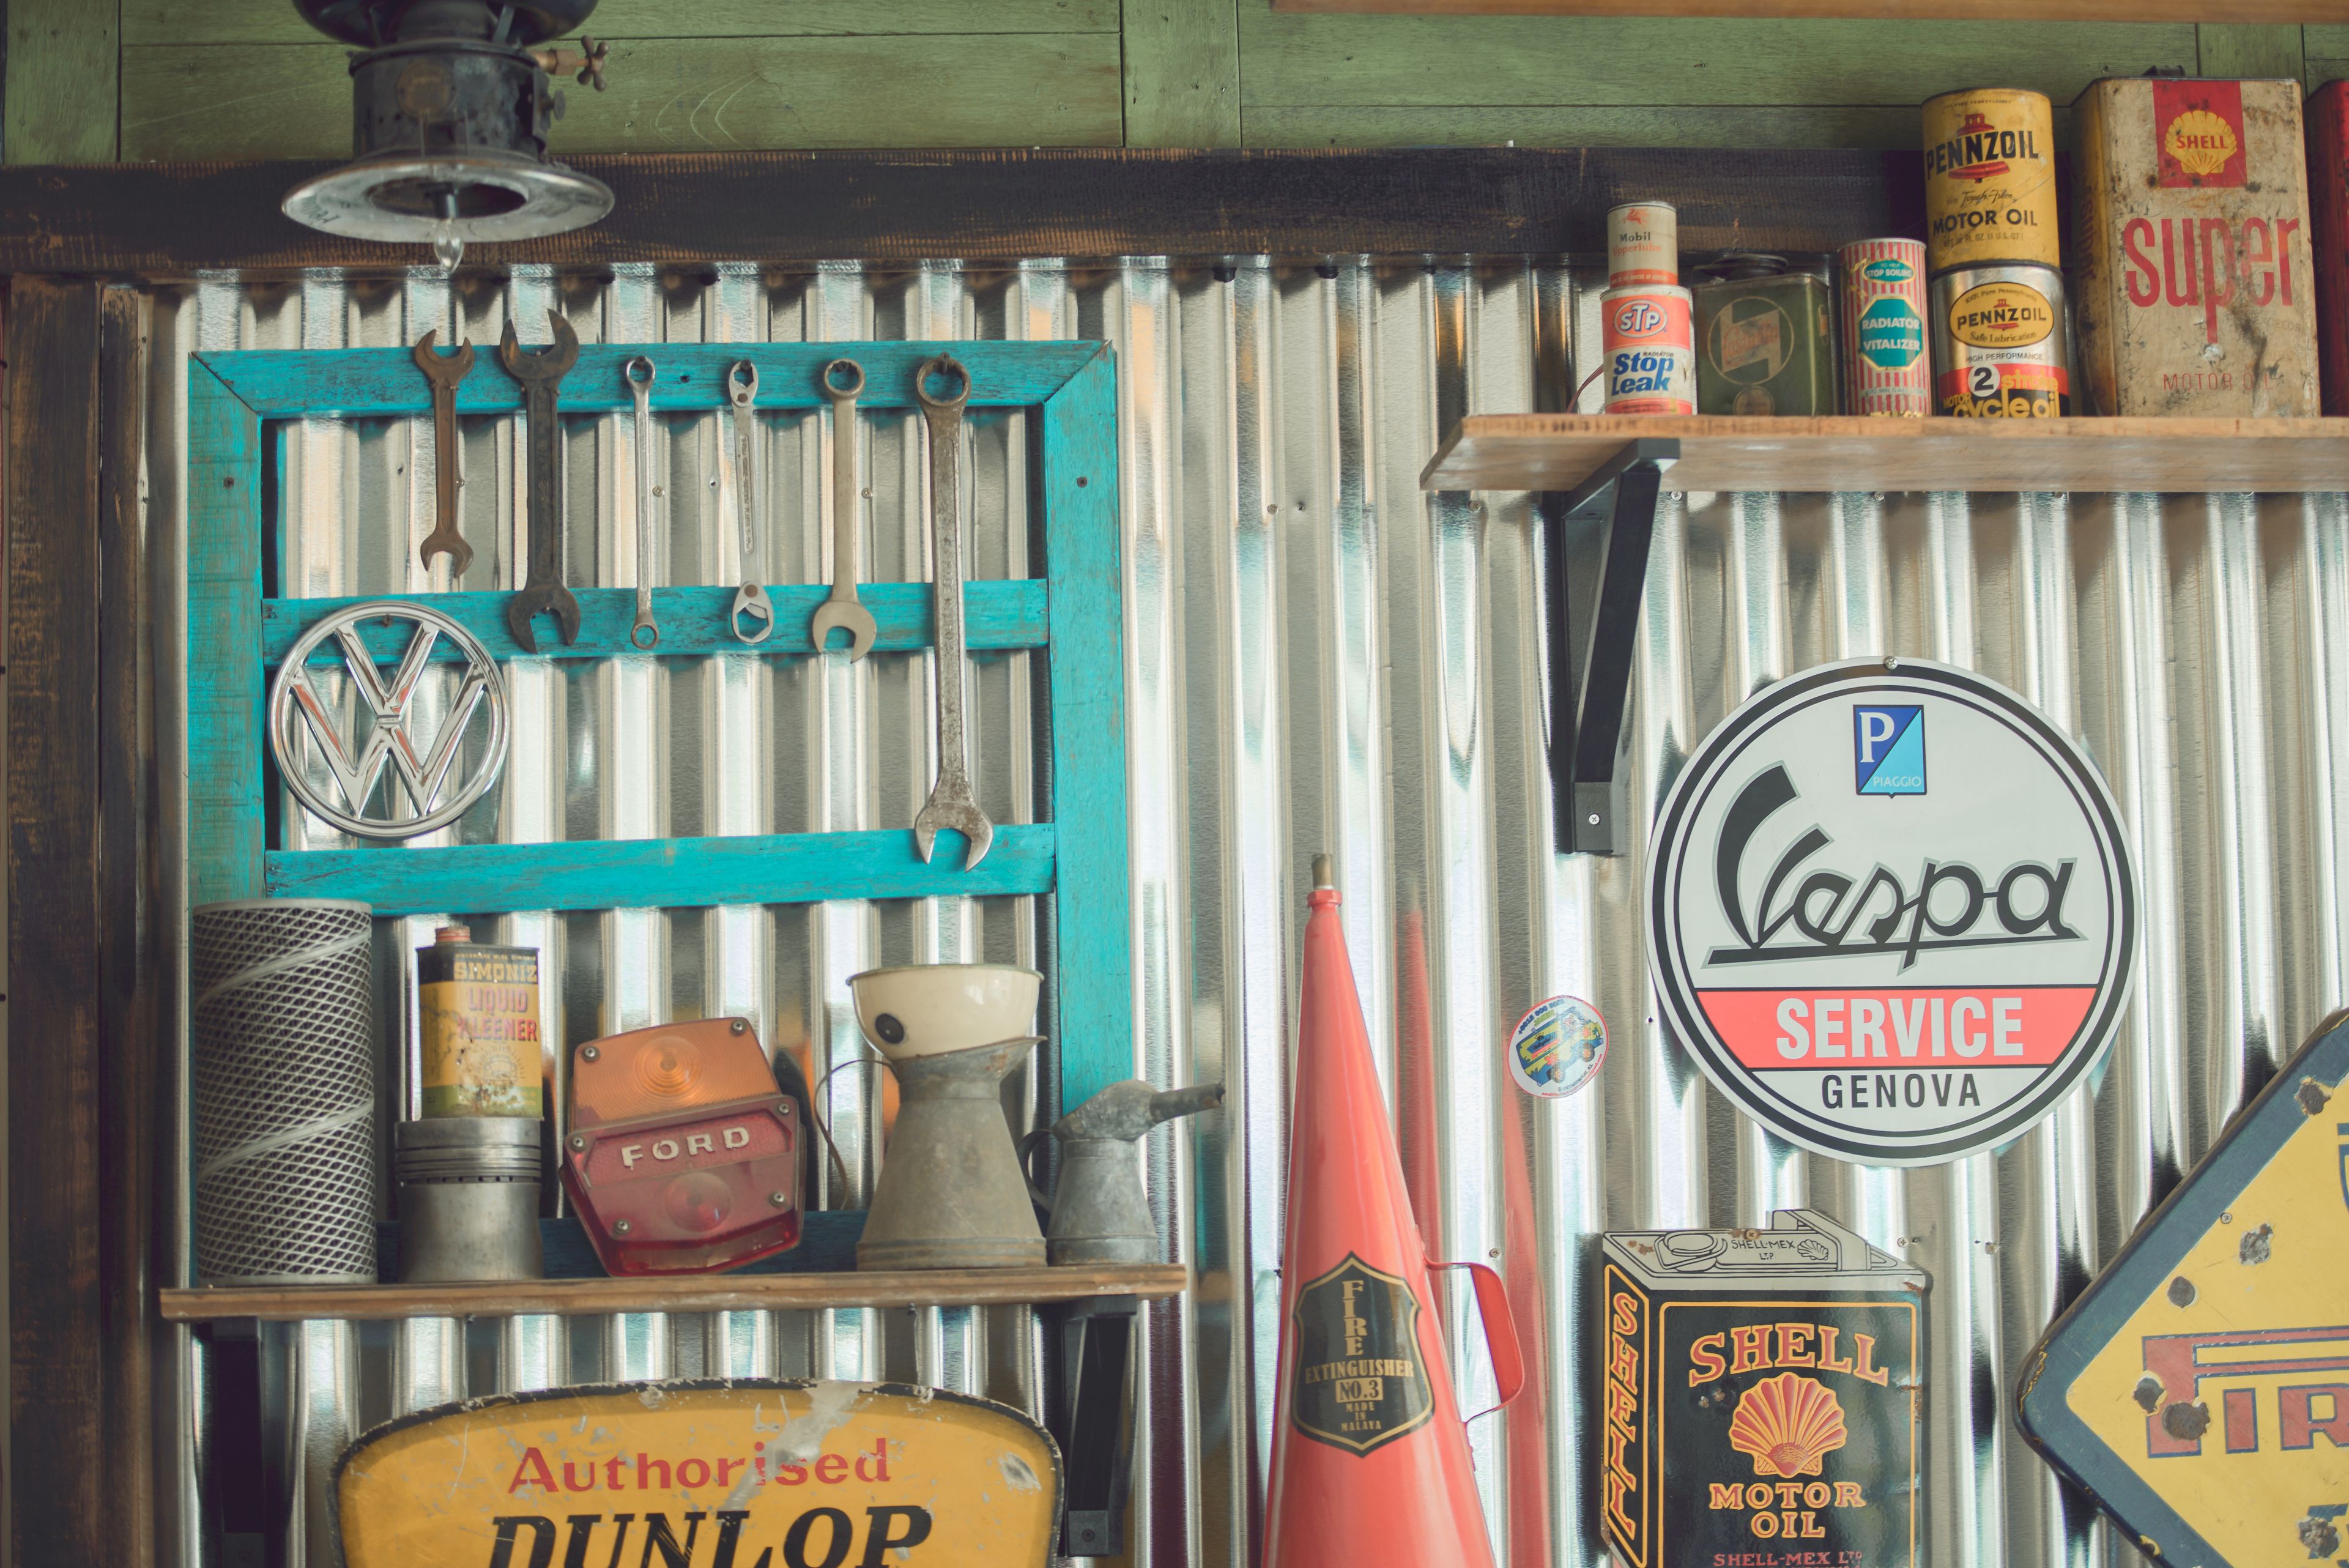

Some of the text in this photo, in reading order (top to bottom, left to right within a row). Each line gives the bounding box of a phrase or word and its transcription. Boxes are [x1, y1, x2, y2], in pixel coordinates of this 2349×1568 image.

[2176, 135, 2229, 150] SHELL
[1927, 130, 2039, 181] PENNZOIL
[1933, 209, 2038, 236] MOTOR OIL
[1620, 232, 1651, 242] Mobil
[1866, 269, 1884, 278] STOP
[2123, 217, 2300, 344] super
[1620, 303, 1660, 332] STP
[1861, 317, 1920, 330] RADIATOR
[1958, 308, 2047, 331] PENNZOIL
[1863, 338, 1920, 351] VITALIZER
[1970, 331, 2037, 343] Safe Lubrication
[1613, 352, 1674, 376] Stop
[1966, 352, 2043, 363] HIGH PERFORMANCE
[1611, 374, 1672, 396] Leak
[1973, 367, 2058, 392] 2 stroke
[2163, 372, 2273, 392] MOTOR OL
[285, 615, 491, 822] VW
[1858, 712, 1895, 764] P
[1872, 775, 1922, 788] PIAGGIO
[1707, 764, 2081, 971] Vespa
[454, 962, 538, 983] SIMONIZ
[467, 987, 528, 1015] LIQUID
[458, 1018, 538, 1042] KLEENER
[1776, 996, 2024, 1060] SERVICE
[1820, 1072, 1981, 1109] GENOVA
[621, 1126, 751, 1168] FORD
[1341, 1279, 1368, 1356] FIRE
[1688, 1323, 1889, 1388] SHELL
[1305, 1359, 1414, 1384] EXTINGUISHER
[1345, 1402, 1375, 1413] MADE
[1354, 1412, 1367, 1421] IN
[1609, 1291, 1639, 1541] SHELL
[1341, 1420, 1382, 1432] MALAYA
[507, 1437, 891, 1495] Authorised
[1709, 1481, 1867, 1510] MOTOR
[488, 1503, 935, 1568] DUNLOP
[1751, 1511, 1826, 1539] OIL
[1712, 1551, 1831, 1567] SHELL-MEX
